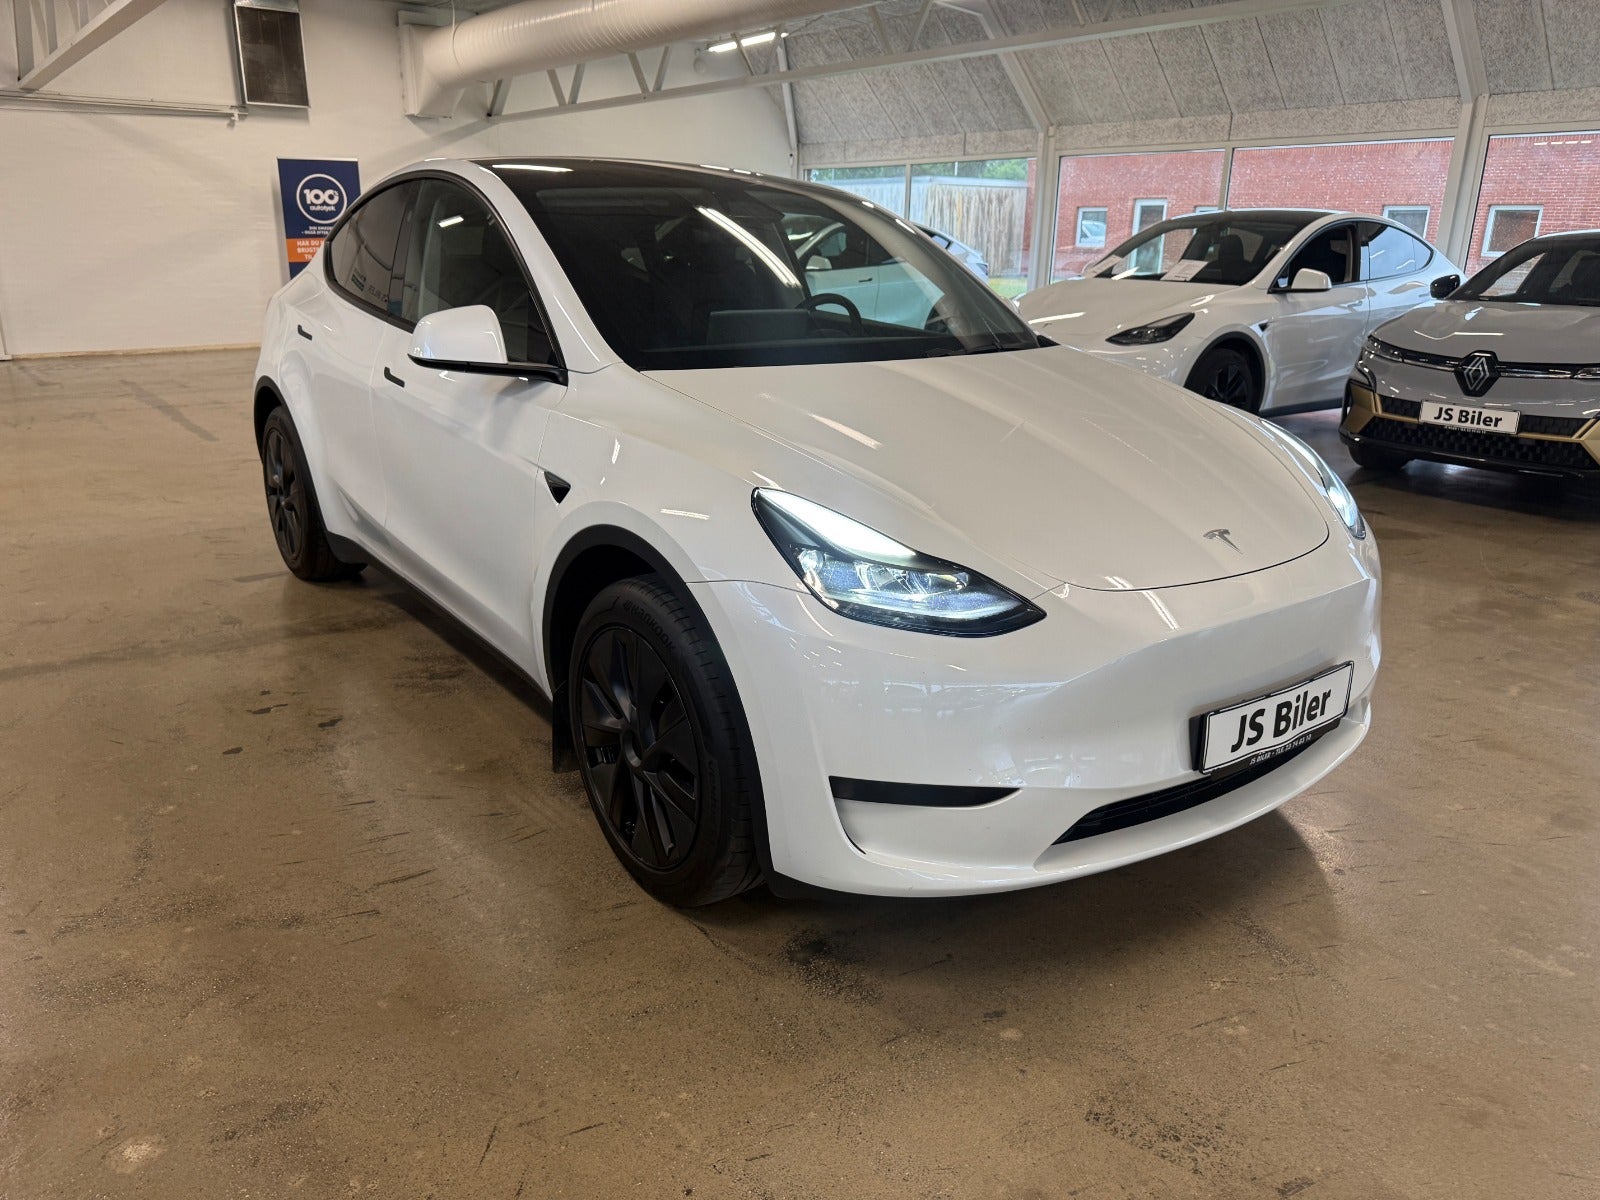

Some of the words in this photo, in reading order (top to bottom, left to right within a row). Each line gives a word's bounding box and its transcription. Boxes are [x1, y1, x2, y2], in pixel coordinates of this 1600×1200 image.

[1434, 406, 1454, 421] JS
[1457, 409, 1503, 428] Biler
[1230, 708, 1266, 753] JS
[1273, 689, 1332, 738] Biler
